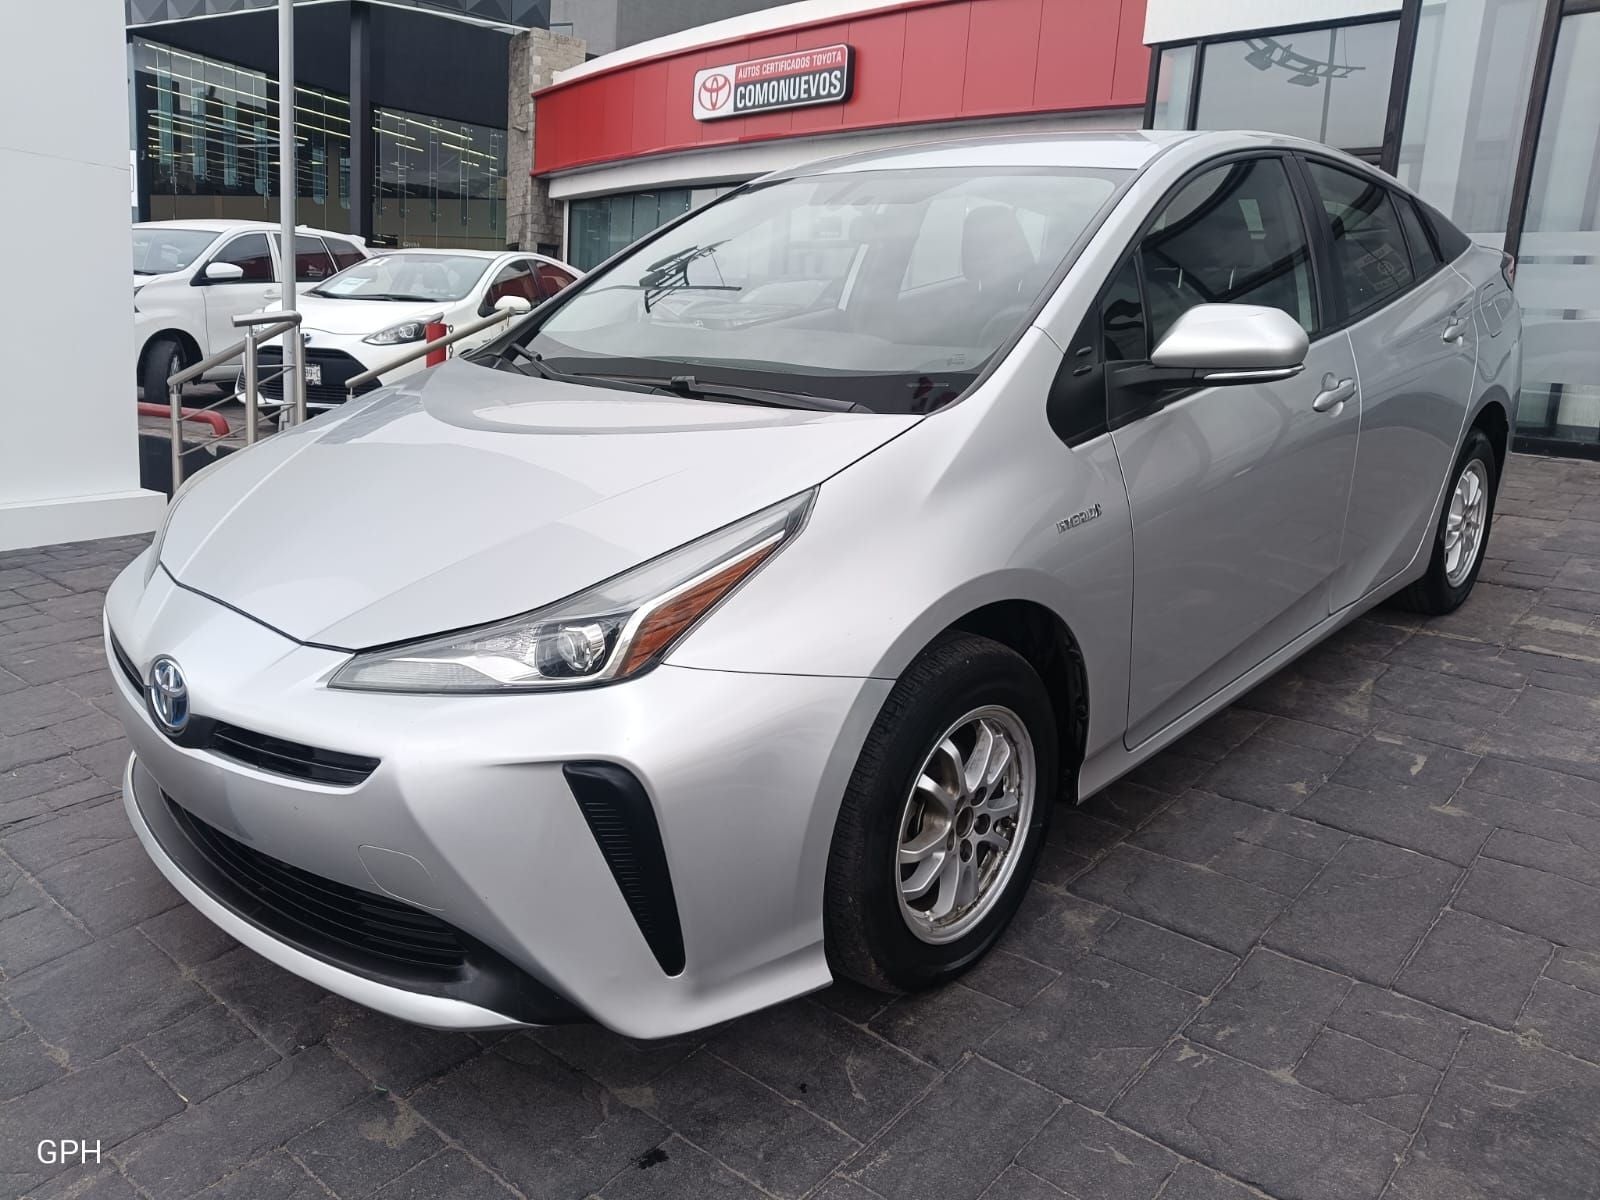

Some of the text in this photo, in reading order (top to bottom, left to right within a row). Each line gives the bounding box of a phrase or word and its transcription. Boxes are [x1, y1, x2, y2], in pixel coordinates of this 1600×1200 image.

[738, 50, 842, 79] AUTOS CERTIFICADOS TOYOTA
[736, 70, 841, 108] COMONUEVOS
